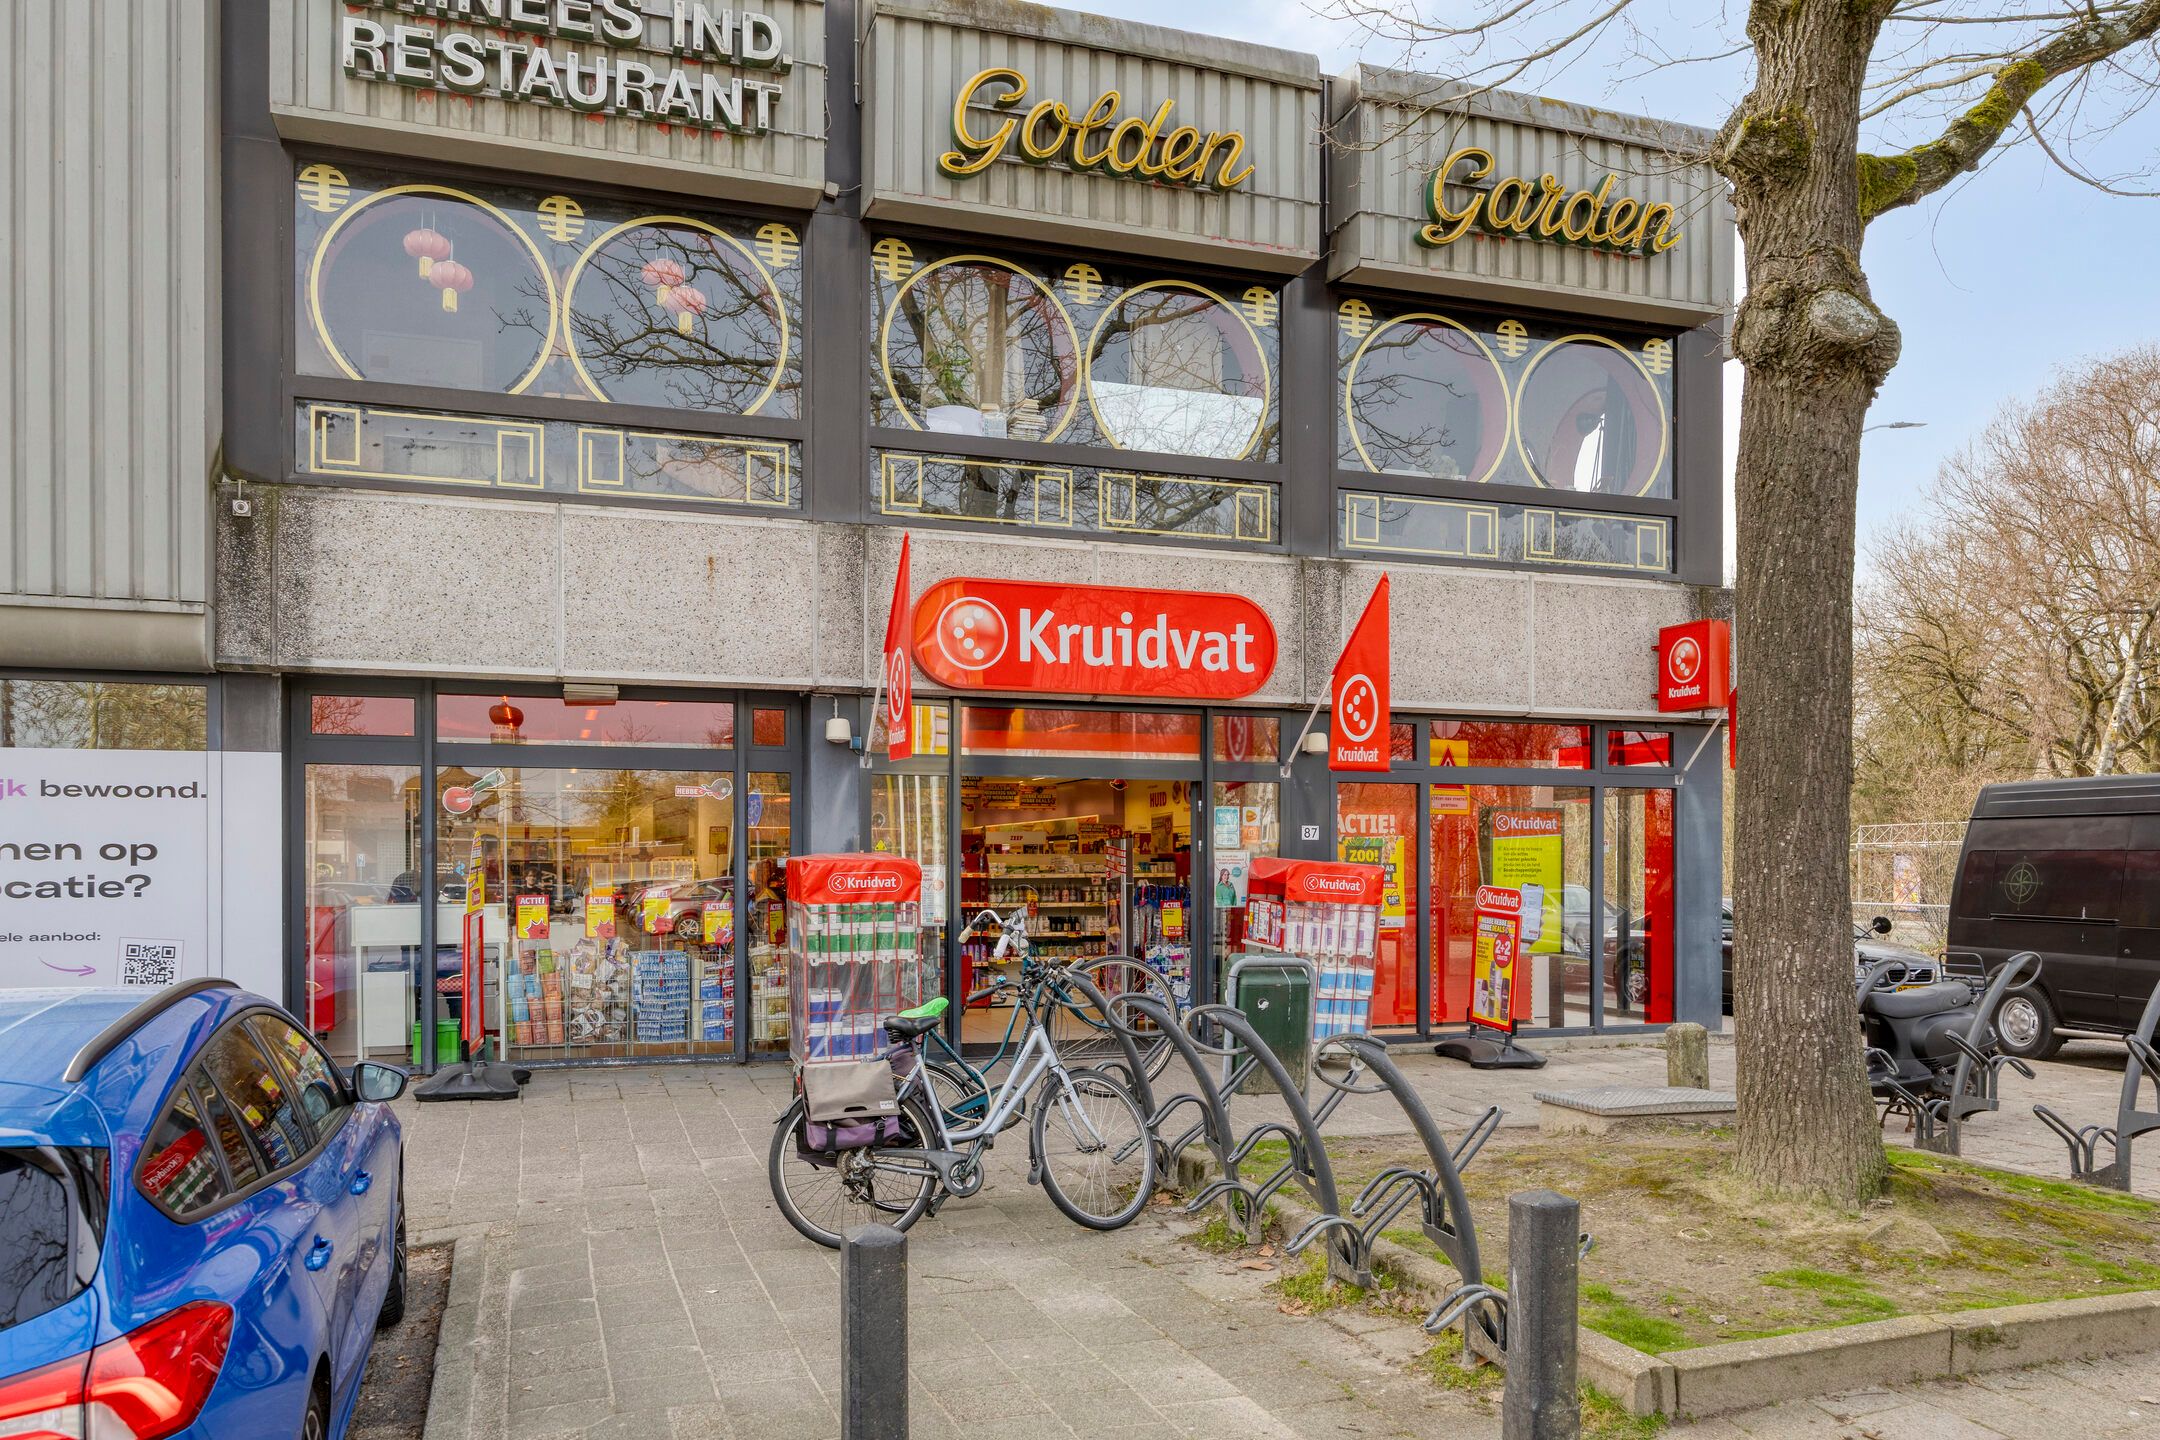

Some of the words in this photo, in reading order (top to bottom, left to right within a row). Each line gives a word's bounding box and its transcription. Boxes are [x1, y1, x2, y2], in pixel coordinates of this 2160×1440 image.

[342, 16, 783, 135] RESTAURANT
[938, 67, 1255, 190] Golden
[1417, 146, 1684, 255] Garden
[1019, 608, 1255, 673] Kruidvat
[1668, 685, 1701, 698] Kruidvat
[1337, 746, 1379, 762] Kruidvat
[40, 779, 208, 799] bewoond.
[1149, 791, 1167, 808] HUID
[1510, 816, 1558, 830] Kruidvat
[1304, 828, 1318, 838] 87
[99, 843, 158, 867] op
[1349, 849, 1379, 863] ZOO!
[0, 873, 152, 899] catie?
[847, 876, 897, 889] Kruidvat
[1319, 877, 1361, 892] Kruidvat
[1487, 891, 1519, 907] Kruidvat
[29, 931, 101, 942] aanbod:
[1495, 939, 1511, 956] 2+2
